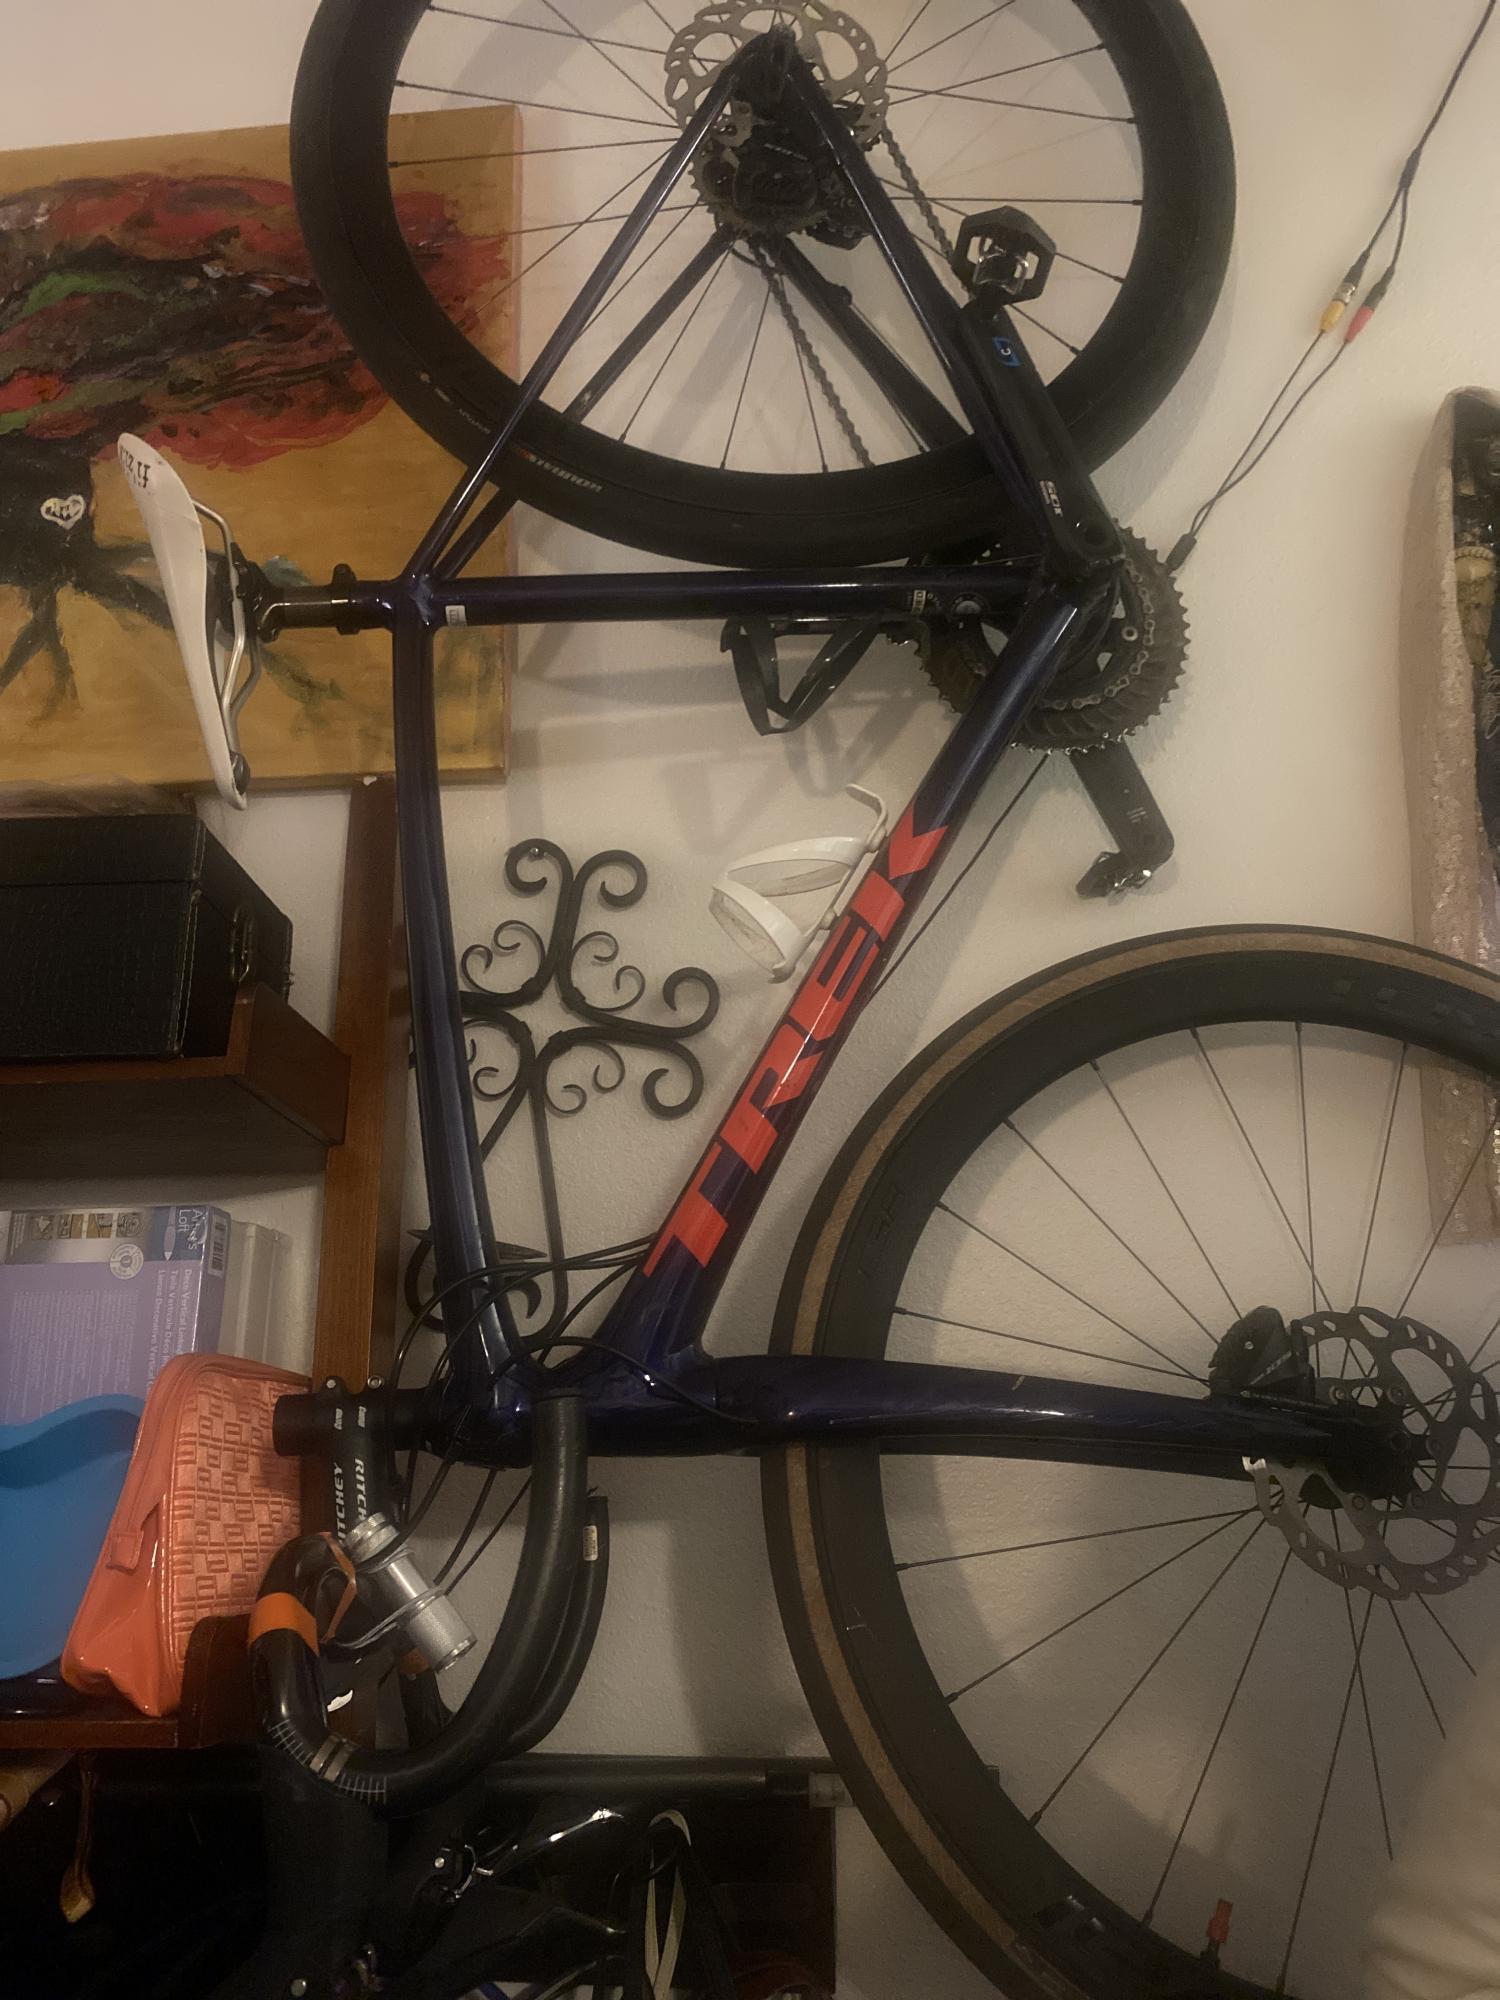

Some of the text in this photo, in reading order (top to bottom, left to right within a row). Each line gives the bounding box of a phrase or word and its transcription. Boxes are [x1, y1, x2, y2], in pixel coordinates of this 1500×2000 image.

[643, 805, 949, 1277] TREK
[178, 1209, 192, 1232] Loft
[180, 1291, 192, 1326] Vertical
[334, 1462, 346, 1546] ITCHEY
[354, 1458, 367, 1521] RITCH
